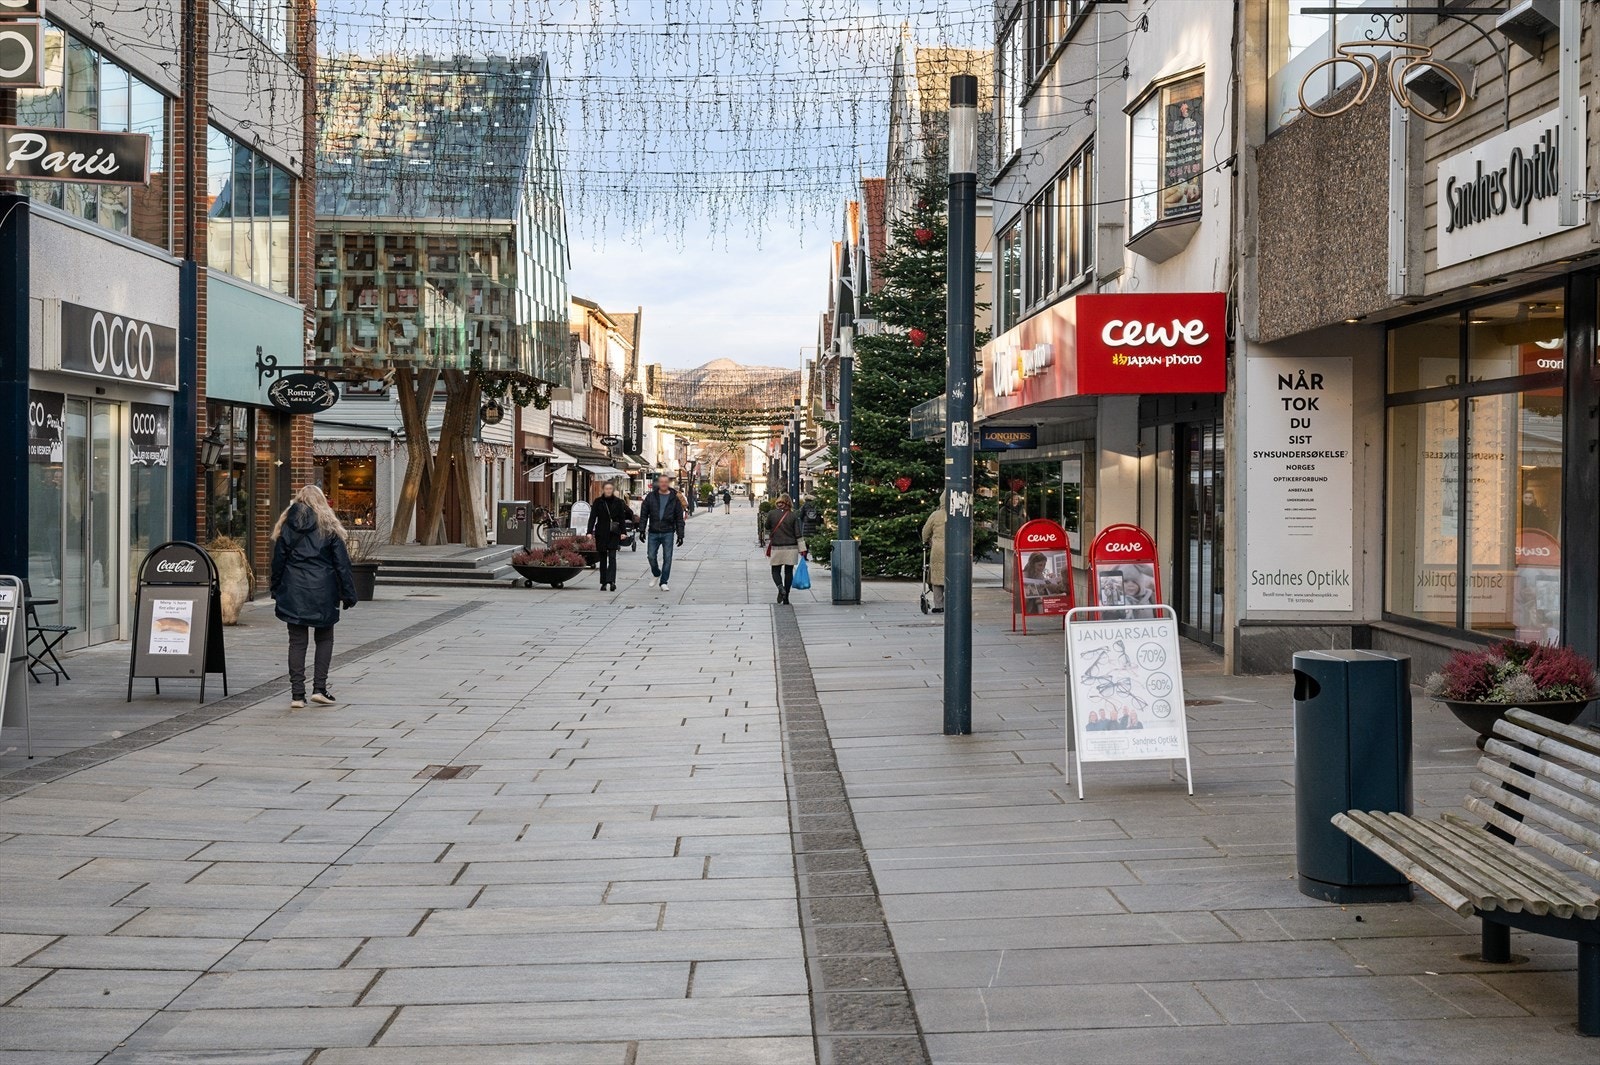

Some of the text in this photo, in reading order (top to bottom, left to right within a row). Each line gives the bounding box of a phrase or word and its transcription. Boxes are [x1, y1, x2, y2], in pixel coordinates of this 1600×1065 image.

[6, 133, 120, 175] Paris
[1446, 160, 1507, 233] Sandnes
[1102, 319, 1209, 347] cewe
[91, 312, 154, 380] OCCO
[1278, 369, 1324, 390] NÅR
[287, 389, 316, 398] Rostrup
[1281, 397, 1319, 411] TOK
[133, 412, 155, 435] OCCO
[1290, 418, 1311, 429] DU
[985, 432, 1031, 440] LONGINES
[1289, 435, 1312, 444] SIST
[1253, 450, 1348, 459] SYNSUNDERSØKELSE?
[1027, 533, 1057, 543] cewe
[1105, 541, 1142, 552] cewe
[157, 559, 196, 573] Coca-Cola
[1252, 569, 1350, 590] Sandnes Optikk
[1077, 626, 1168, 642] JANUARSALG
[1139, 650, 1164, 663] -70%
[1148, 679, 1171, 691] -50%
